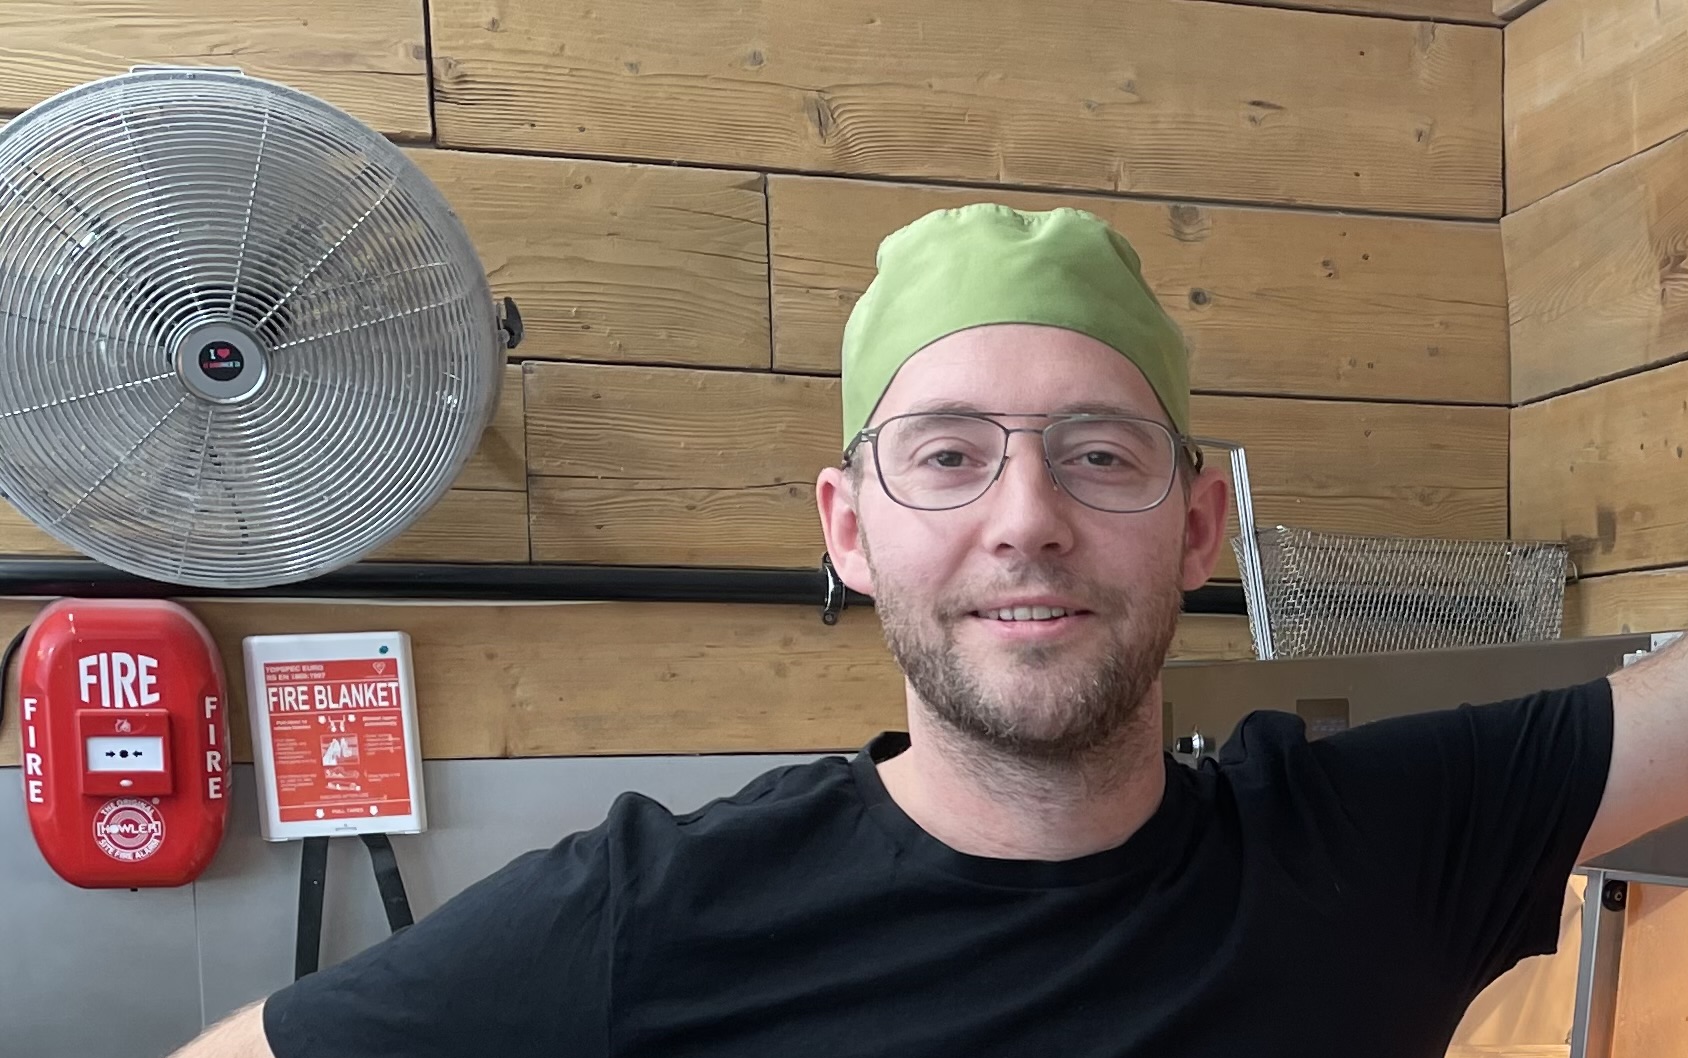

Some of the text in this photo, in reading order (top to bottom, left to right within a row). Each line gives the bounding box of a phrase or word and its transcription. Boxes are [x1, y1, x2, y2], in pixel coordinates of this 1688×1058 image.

[78, 652, 160, 708] FIRE
[268, 682, 399, 712] FIRE BLANKET
[24, 698, 44, 803] FIRE
[204, 696, 223, 799] FIRE
[101, 823, 157, 834] HOWLER
